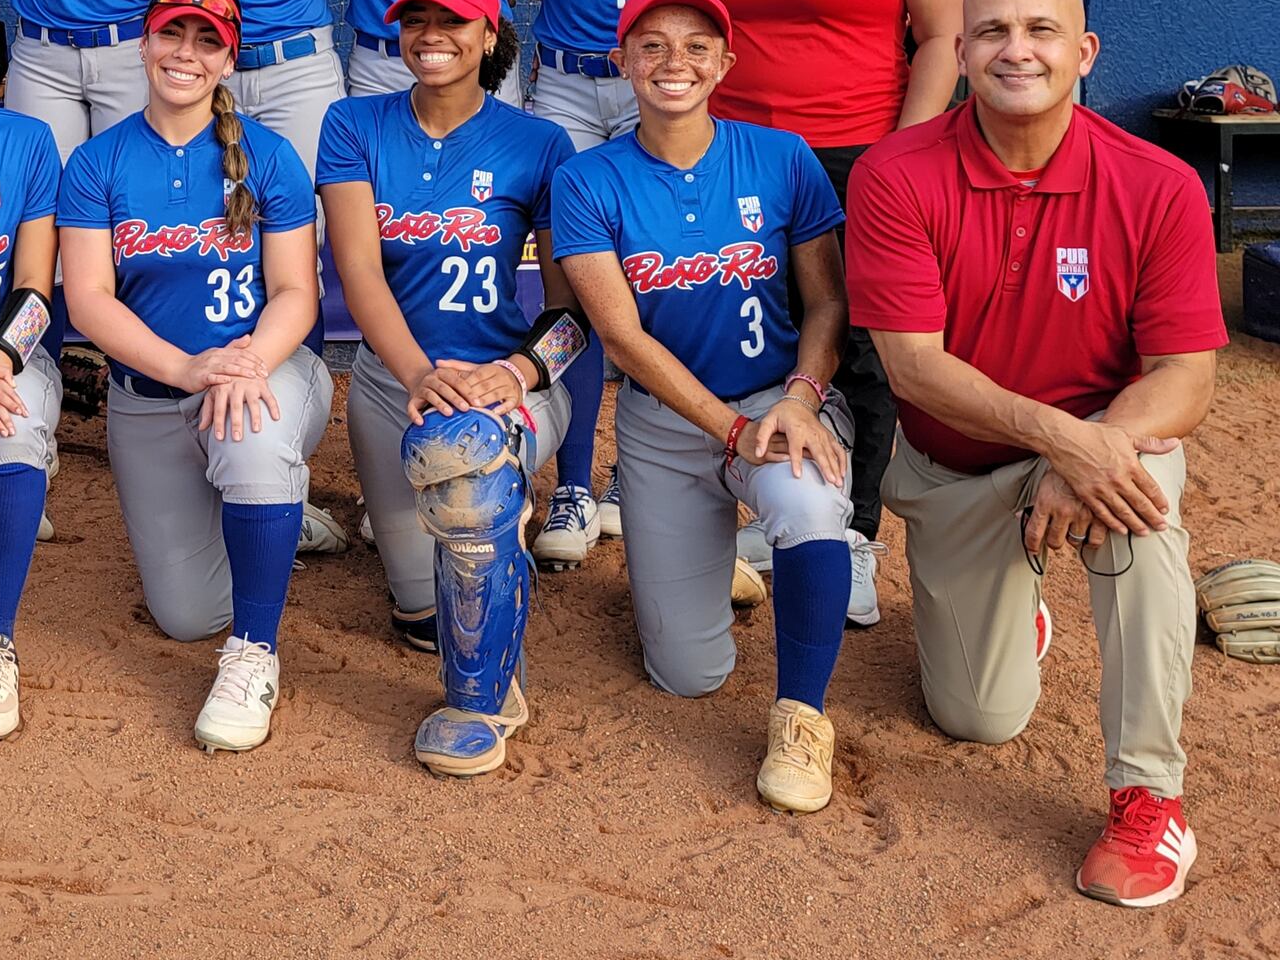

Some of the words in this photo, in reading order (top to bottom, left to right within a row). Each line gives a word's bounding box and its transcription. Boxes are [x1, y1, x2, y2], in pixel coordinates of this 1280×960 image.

[737, 196, 760, 208] PUR
[113, 219, 198, 265] Puerto
[440, 207, 502, 251] Rico
[622, 251, 719, 294] Puerto
[718, 242, 778, 289] Rico
[1056, 247, 1088, 265] PUR
[1056, 264, 1088, 273] SOFTBALL
[204, 264, 256, 322] 33
[438, 255, 498, 314] 23
[740, 296, 764, 358] 3
[448, 541, 495, 554] Wilson
